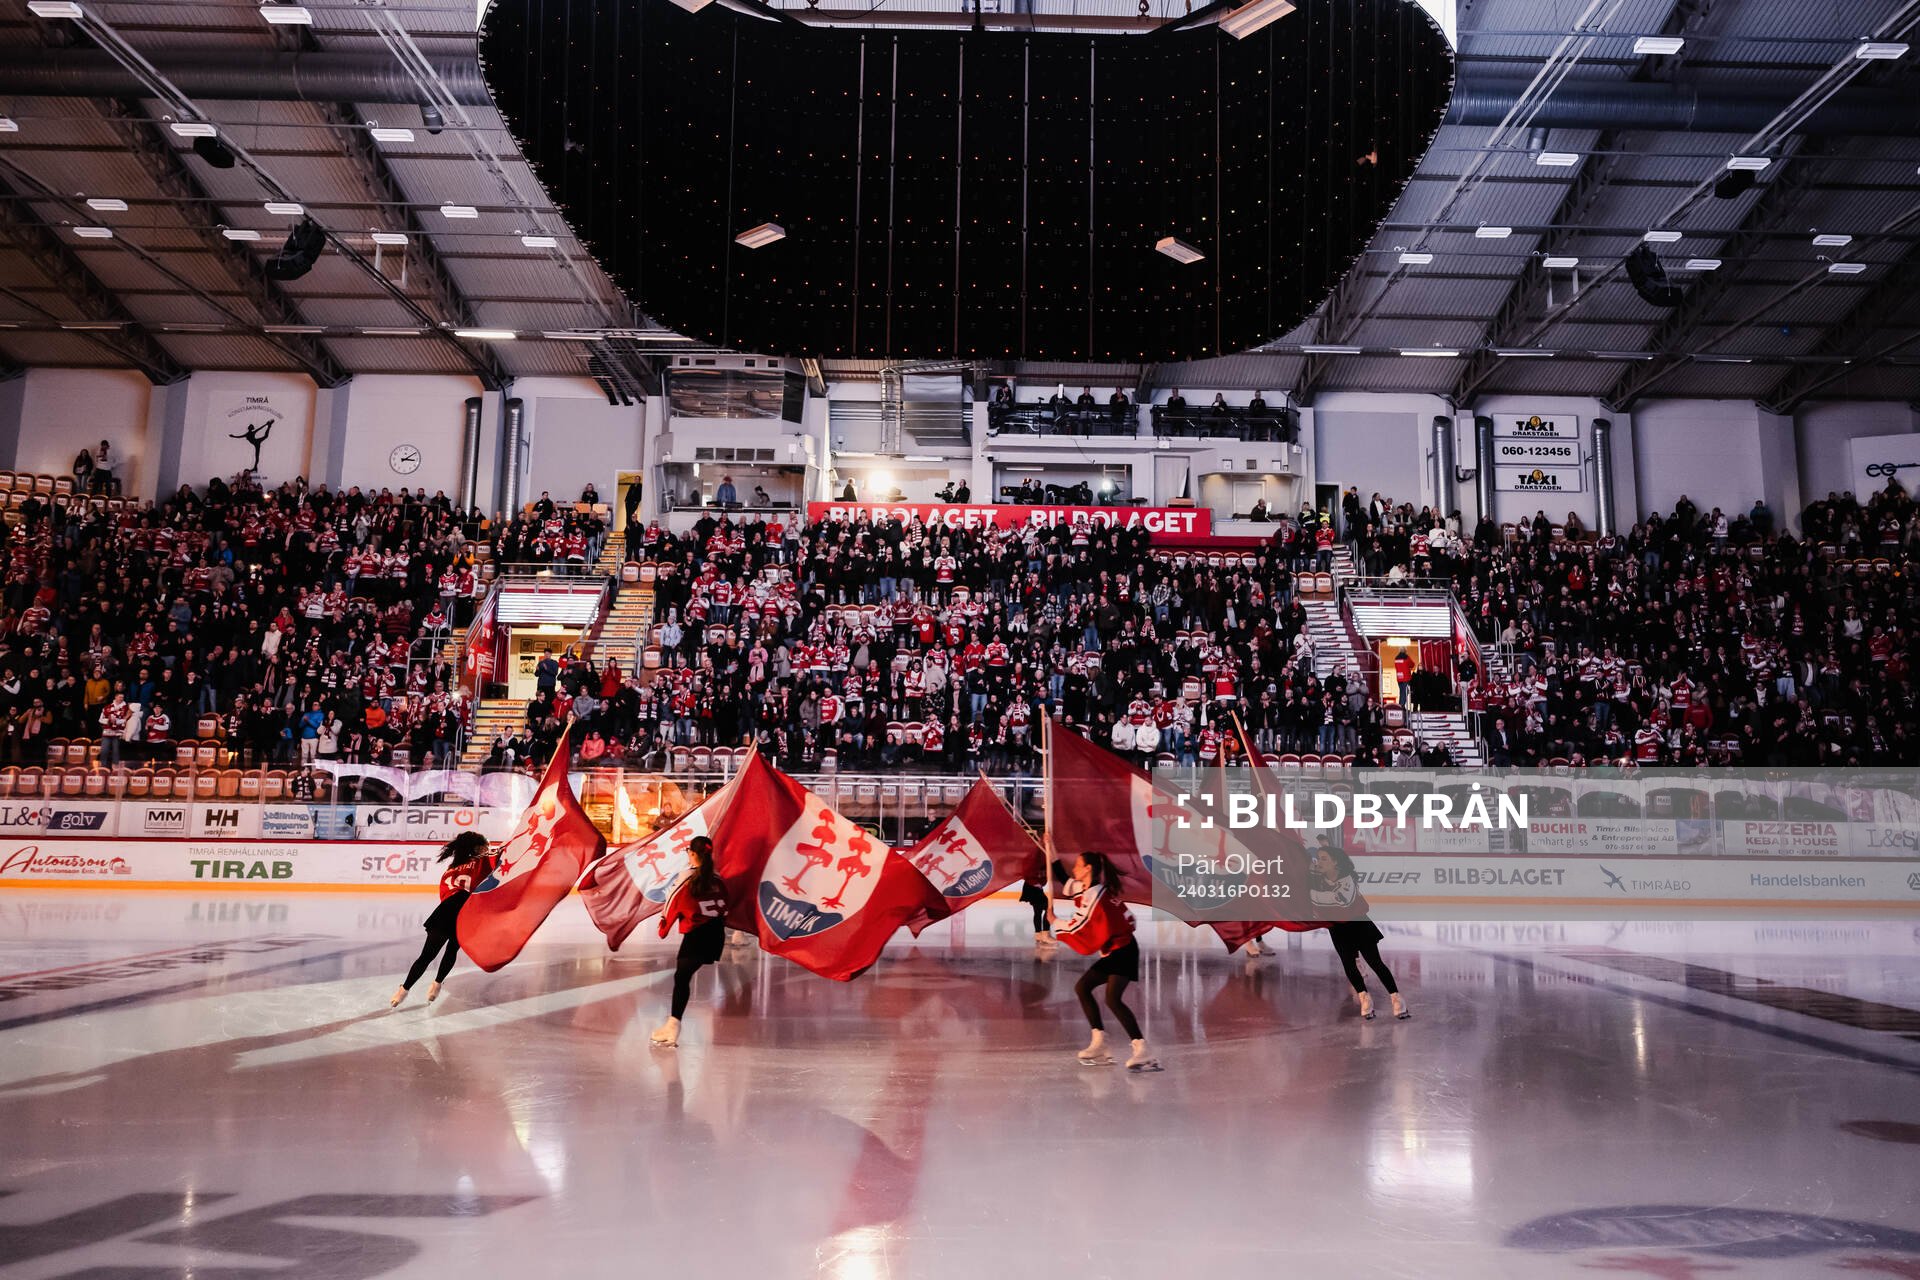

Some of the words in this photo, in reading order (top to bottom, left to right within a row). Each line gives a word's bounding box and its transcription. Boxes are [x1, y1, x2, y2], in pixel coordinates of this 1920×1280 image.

[246, 396, 269, 404] TIMRÅ
[1516, 421, 1554, 431] TAXI
[1502, 446, 1571, 456] 060-123456
[1518, 474, 1557, 485] TAXI
[61, 812, 96, 829] golv
[148, 811, 182, 821] MM
[205, 809, 238, 826] HH
[1530, 823, 1587, 834] BUCHR
[1744, 822, 1838, 837] PIZZERIA
[1352, 825, 1407, 846] AVIS
[1531, 835, 1564, 846] emhart
[1567, 836, 1588, 849] glss
[1745, 836, 1789, 846] KEBAB
[1793, 837, 1839, 847] HOUSE
[287, 848, 299, 857] AB
[0, 845, 108, 874] Antonsson
[190, 860, 294, 879] TIRAB
[1434, 867, 1566, 886] BILBOLAGET
[1750, 873, 1866, 888] Handelsbanken
[1632, 879, 1691, 891] TIMRÅBO
